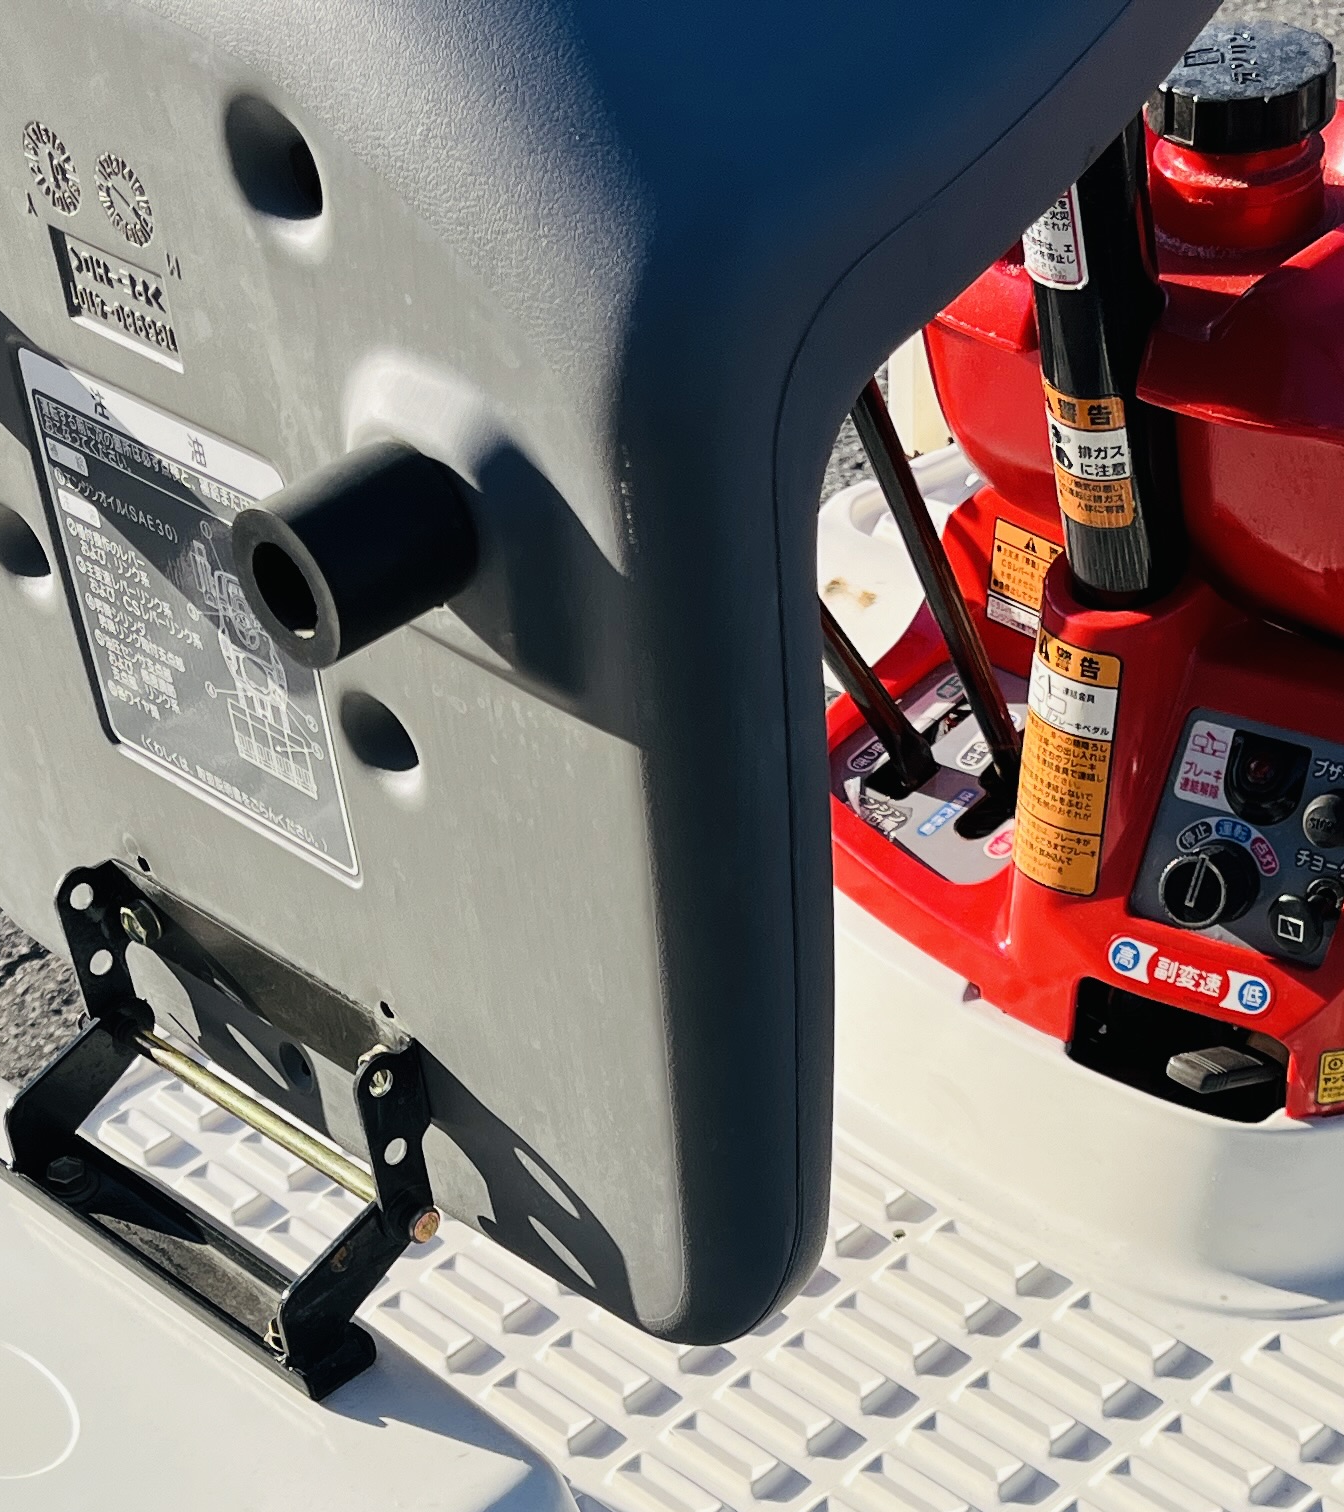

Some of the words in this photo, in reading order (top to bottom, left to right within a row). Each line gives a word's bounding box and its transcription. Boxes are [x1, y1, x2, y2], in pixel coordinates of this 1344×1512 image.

[1078, 444, 1125, 461] 排ガス
[1080, 461, 1127, 477] に注意
[1055, 644, 1102, 682] 警告
[1183, 761, 1223, 784] ブレーキ
[1181, 824, 1210, 849] 停止
[1217, 820, 1249, 842] 運転
[1251, 841, 1276, 871] 点灯
[1114, 944, 1139, 970] 高
[1153, 956, 1223, 998] 副変速
[1242, 983, 1264, 1008] 低
